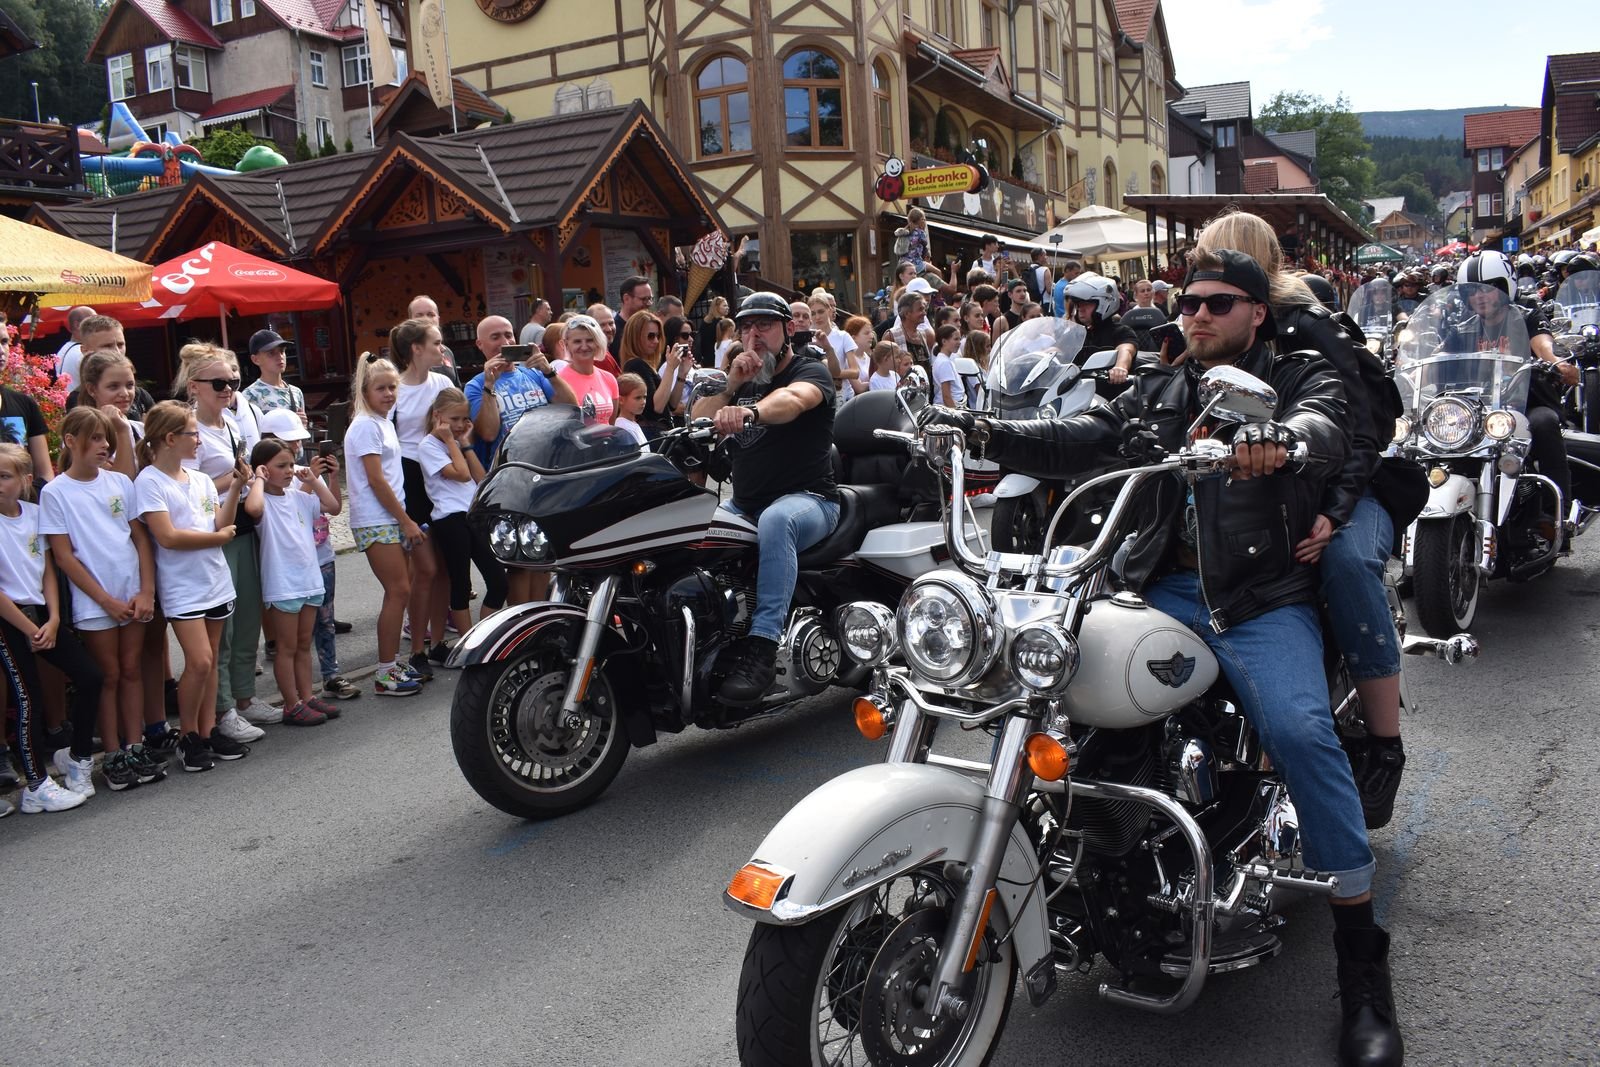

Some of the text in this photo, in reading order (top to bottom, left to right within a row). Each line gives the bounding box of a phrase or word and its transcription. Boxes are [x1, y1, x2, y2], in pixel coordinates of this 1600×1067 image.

[907, 171, 968, 186] Biedronka
[908, 183, 936, 191] Codziennie
[60, 269, 126, 287] Svijany
